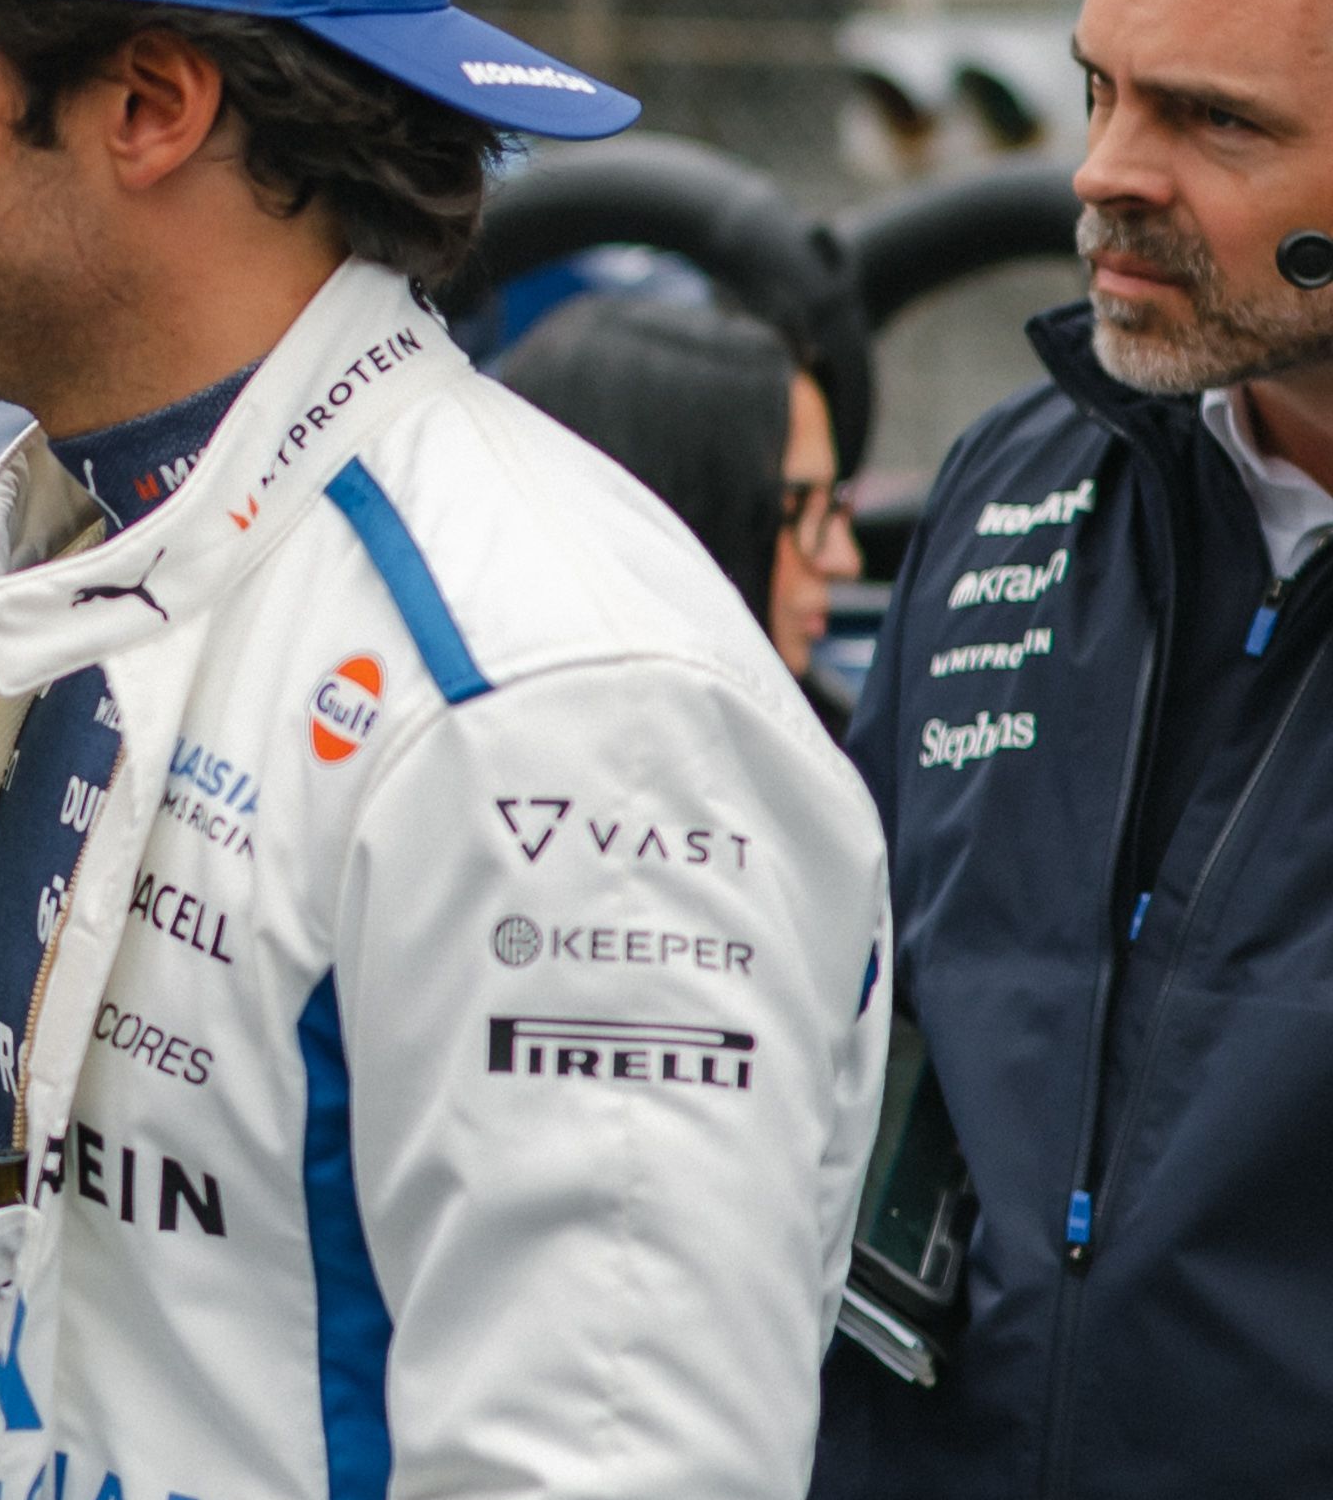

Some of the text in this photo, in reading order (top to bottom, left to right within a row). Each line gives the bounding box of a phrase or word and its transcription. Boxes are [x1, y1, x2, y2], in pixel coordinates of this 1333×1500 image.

[316, 682, 378, 738] Gulf
[589, 820, 749, 869] VAST
[551, 927, 755, 976] KEEPER
[488, 1017, 755, 1089] PIRELLI
